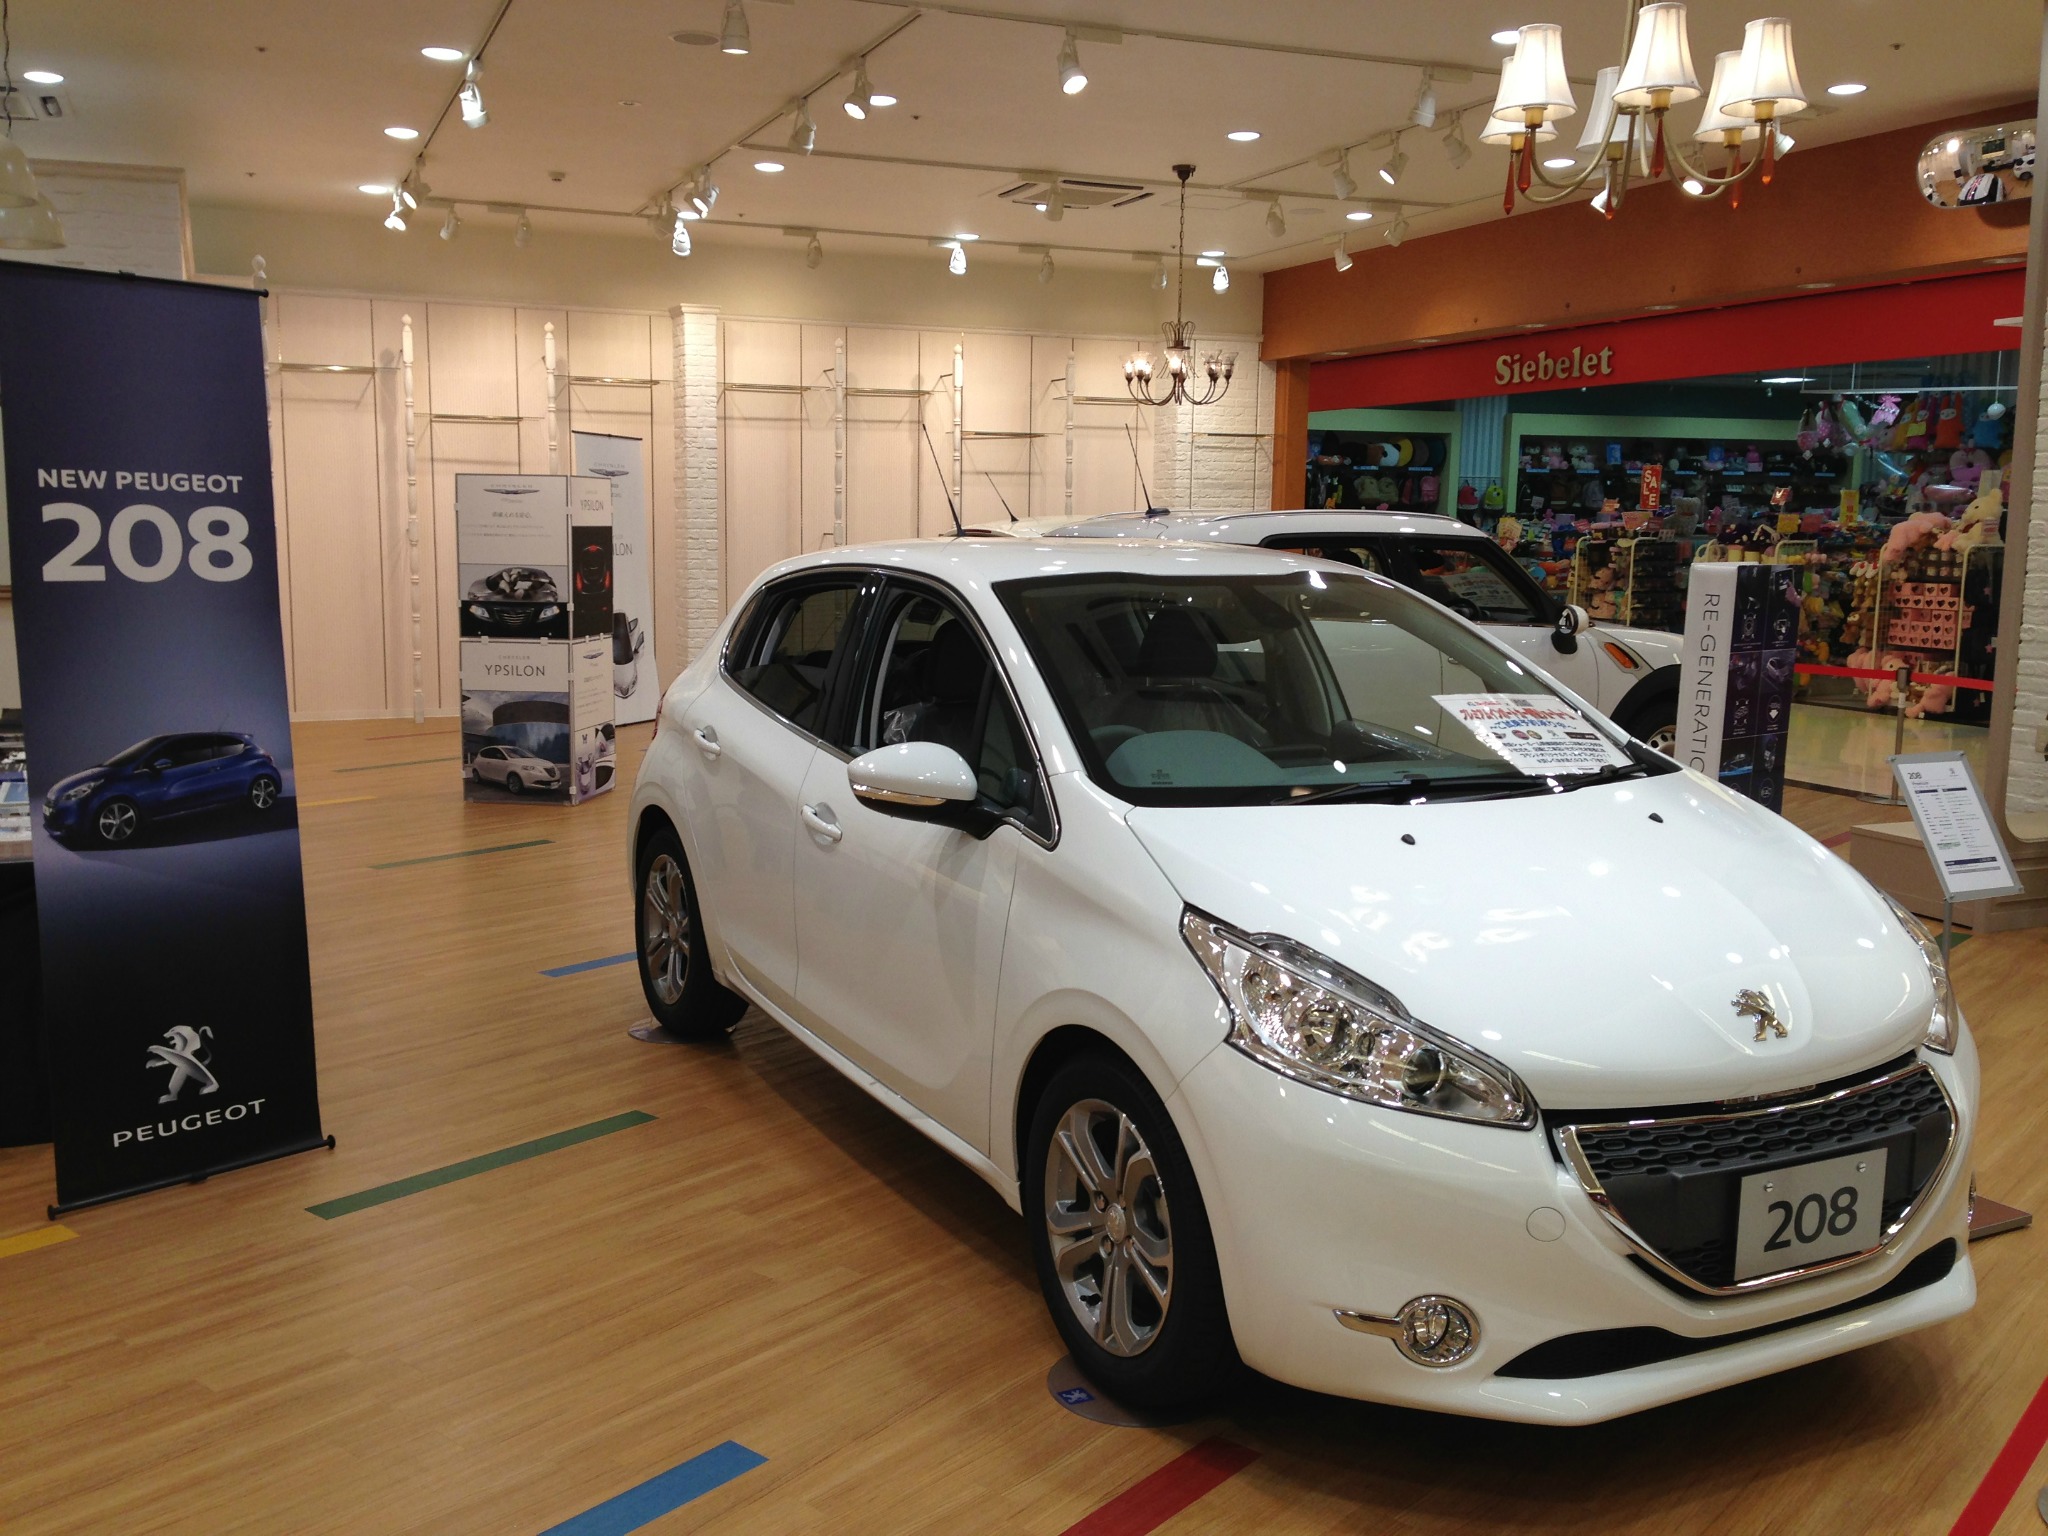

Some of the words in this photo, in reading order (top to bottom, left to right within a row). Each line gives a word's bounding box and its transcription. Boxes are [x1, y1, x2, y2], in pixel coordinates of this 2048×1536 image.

[1494, 346, 1613, 386] Siebelet
[37, 469, 107, 490] NEW
[115, 470, 243, 493] PEUGEOT
[41, 502, 253, 583] 208
[484, 664, 546, 677] YPSILON
[1907, 772, 1922, 780] 208
[112, 1099, 266, 1148] PEUGEOT
[1763, 1186, 1859, 1253] 208
